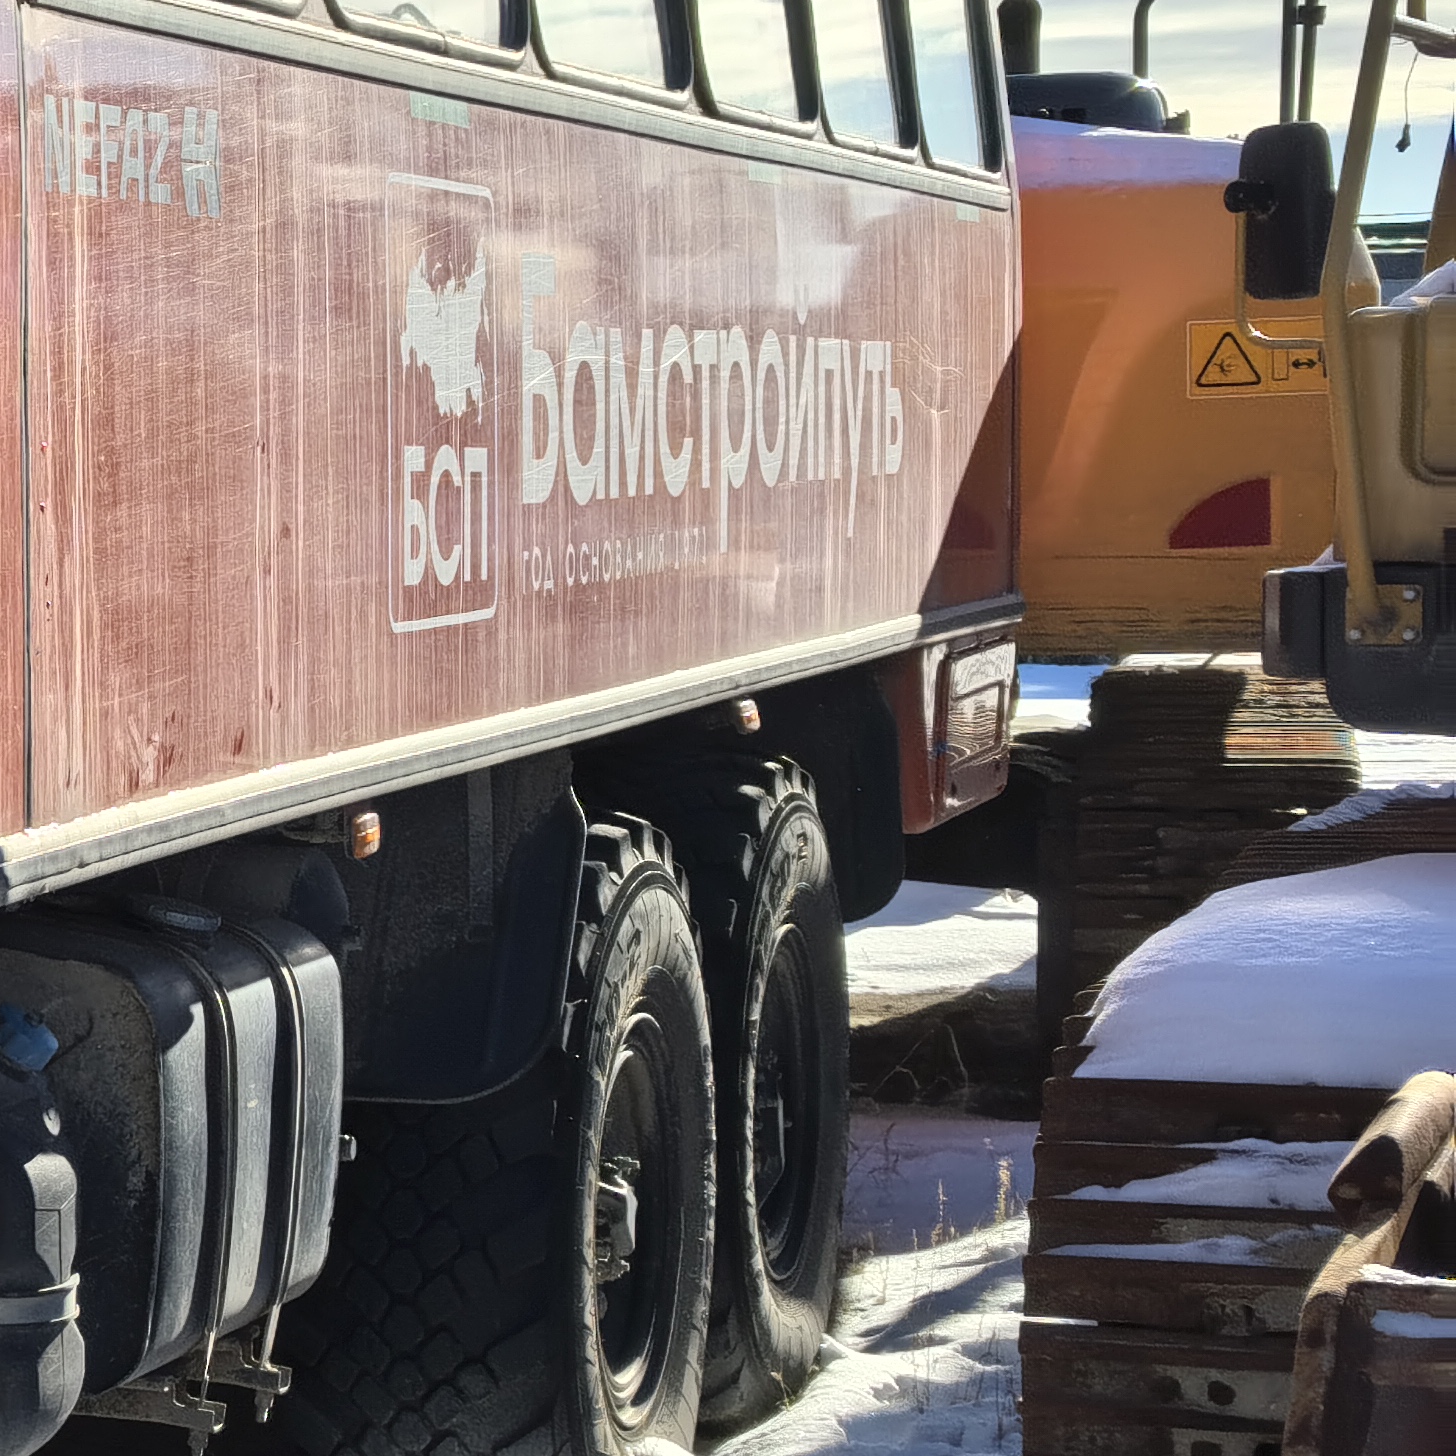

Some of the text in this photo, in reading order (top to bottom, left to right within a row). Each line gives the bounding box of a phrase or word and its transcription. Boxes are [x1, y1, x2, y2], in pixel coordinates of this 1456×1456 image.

[43, 94, 172, 205] NEFAZ
[521, 252, 904, 554] Бамстройпуть
[403, 444, 488, 587] БСП
[522, 545, 555, 597] ГОД
[565, 532, 665, 587] ОСНОВАНИЯ
